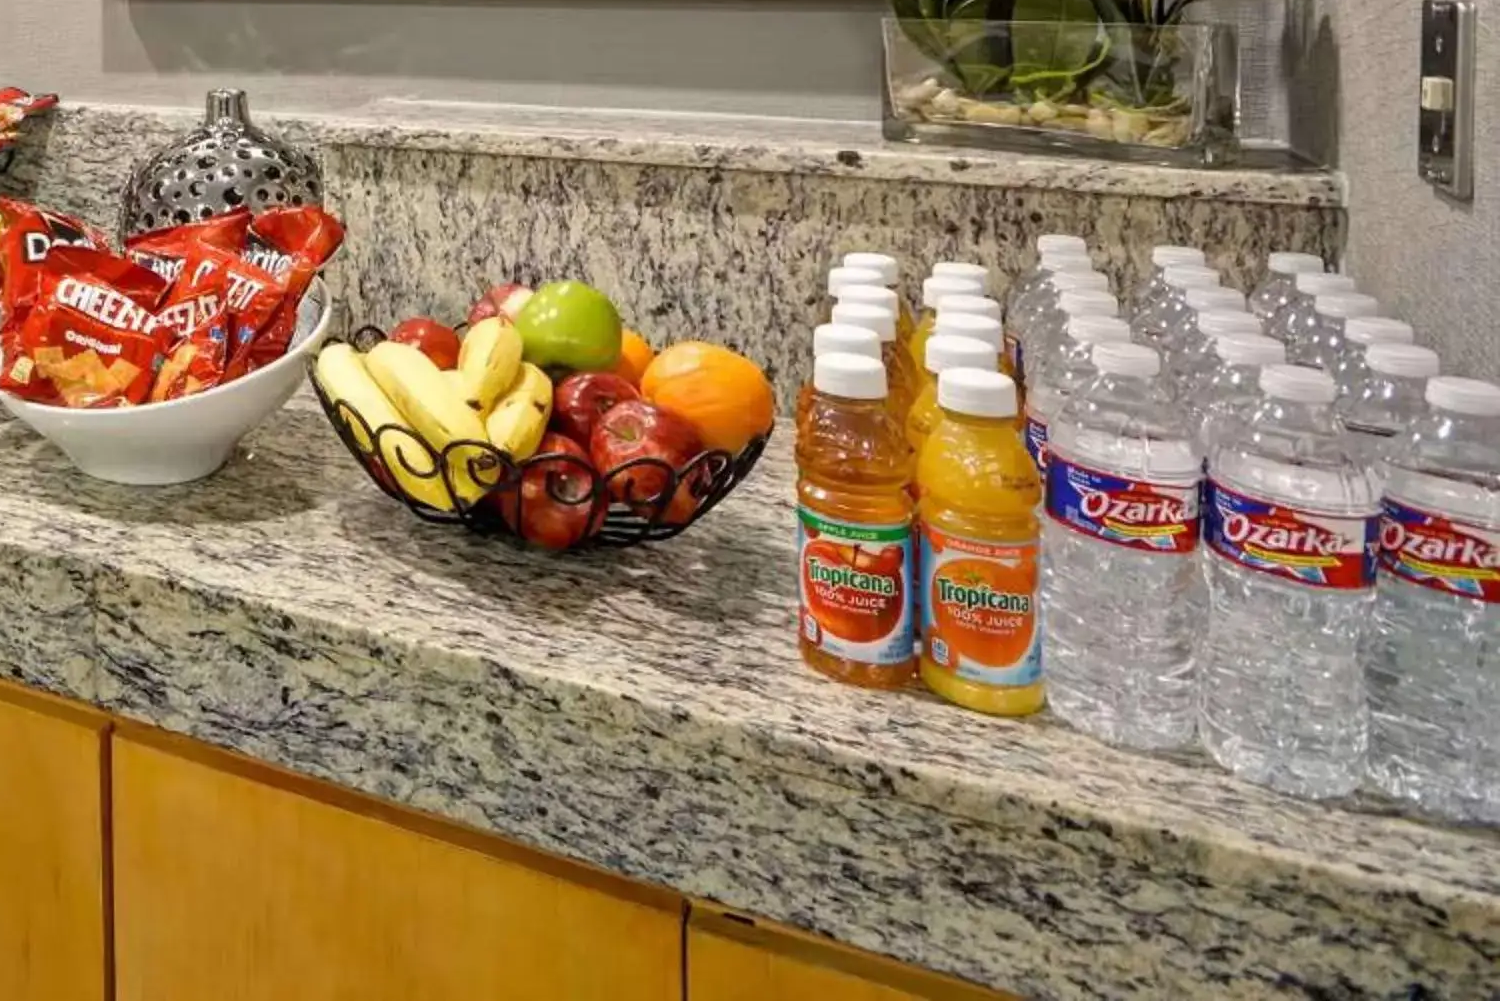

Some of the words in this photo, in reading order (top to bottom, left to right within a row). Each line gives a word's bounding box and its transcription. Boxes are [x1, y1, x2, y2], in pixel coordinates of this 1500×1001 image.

[1080, 491, 1192, 523] Ozarka
[1223, 513, 1348, 556] Ozarka
[809, 557, 895, 597] Tropicana
[815, 585, 846, 604] 100%
[848, 595, 887, 609] JUICE
[937, 577, 1029, 613] Tropicana
[985, 614, 1025, 629] JUICE
